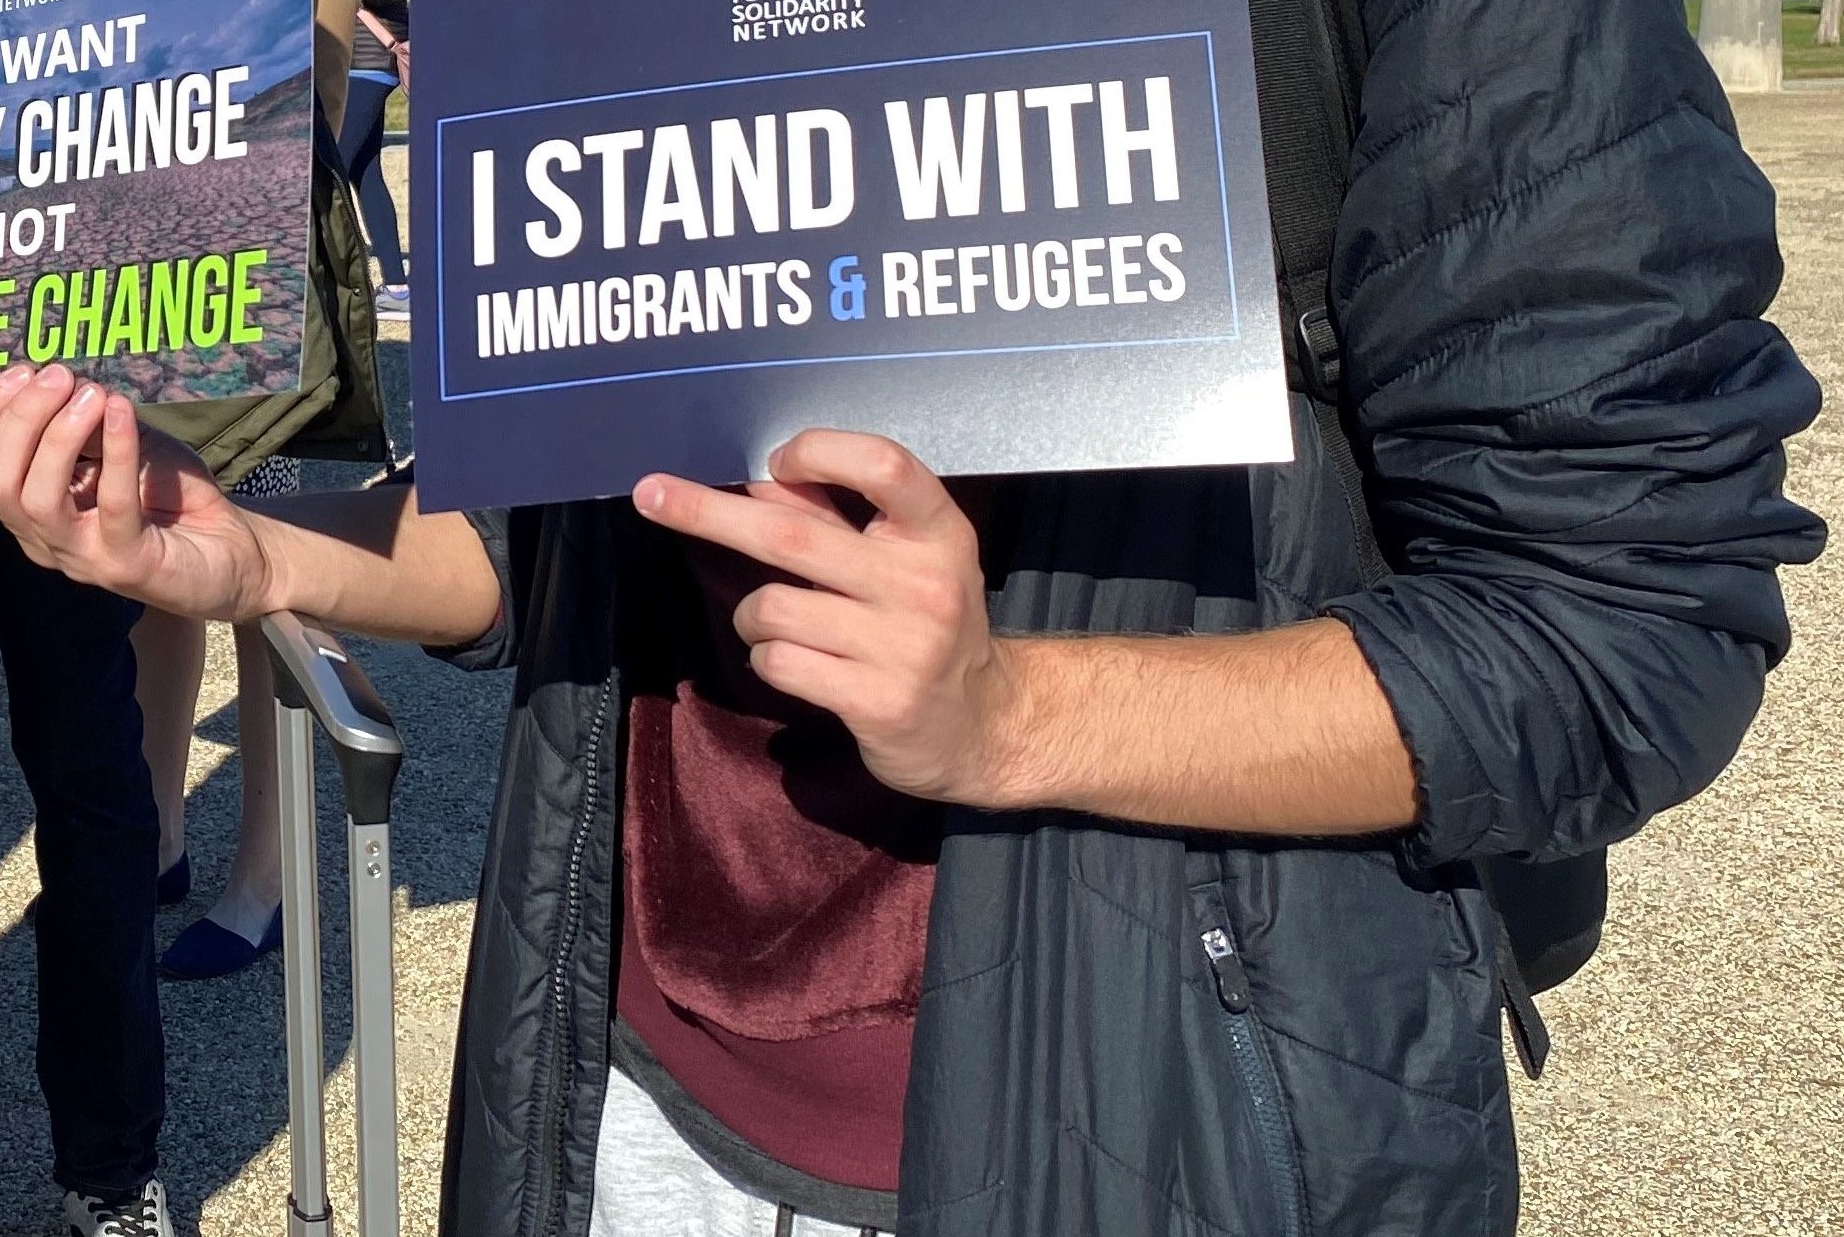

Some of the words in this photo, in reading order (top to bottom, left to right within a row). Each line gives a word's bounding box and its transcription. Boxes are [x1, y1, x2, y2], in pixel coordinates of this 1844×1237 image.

[0, 13, 146, 84] WANT
[732, 9, 866, 43] NETWORK
[18, 65, 249, 188] CHANGE
[472, 149, 495, 266] I
[525, 109, 855, 258] STAND
[884, 76, 1180, 221] WITH
[27, 249, 267, 363] CHANGE
[477, 259, 812, 358] IMMIGRANTS
[828, 255, 866, 321] &
[882, 232, 1187, 319] REFUGEES
